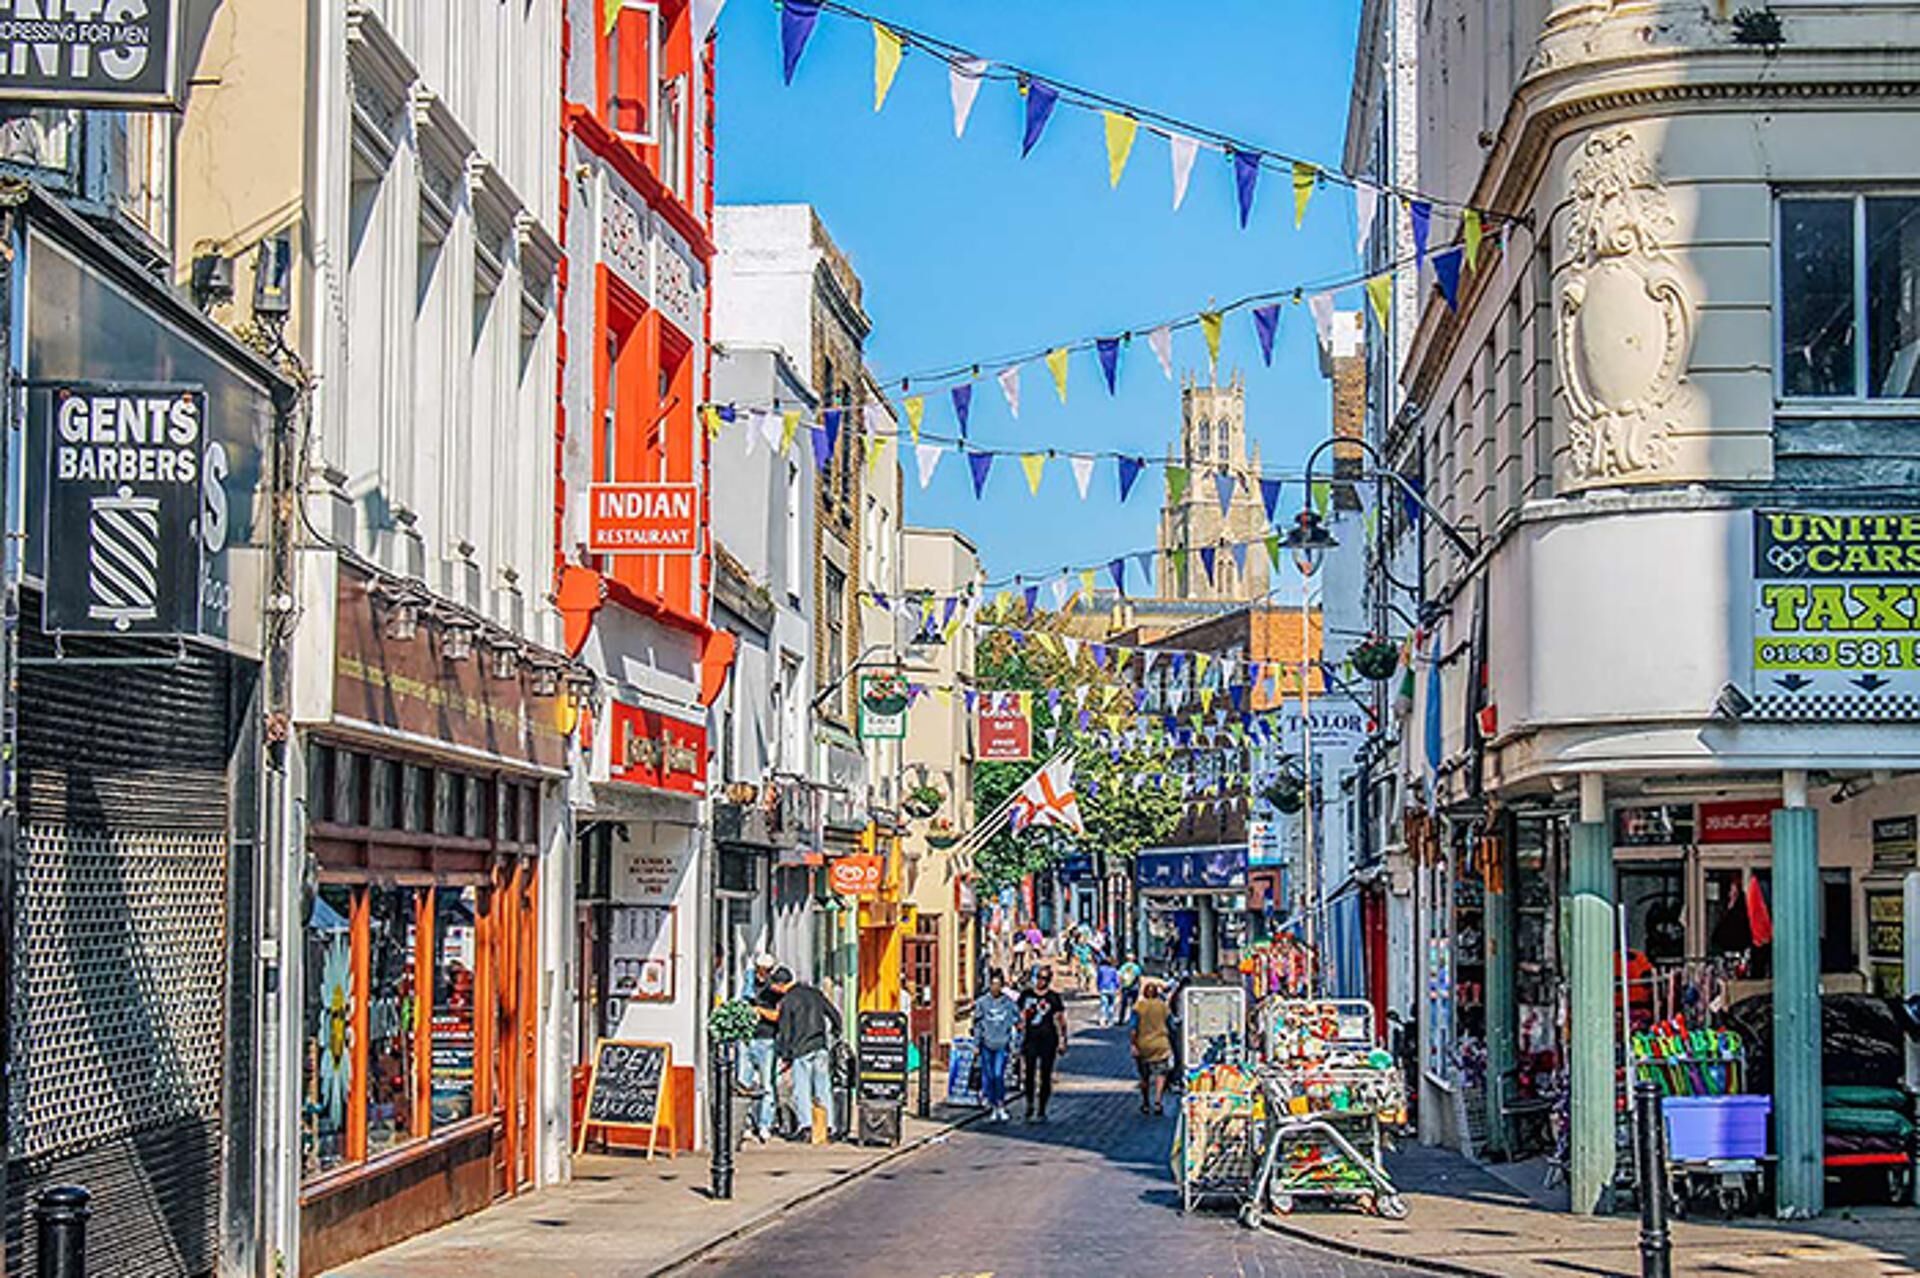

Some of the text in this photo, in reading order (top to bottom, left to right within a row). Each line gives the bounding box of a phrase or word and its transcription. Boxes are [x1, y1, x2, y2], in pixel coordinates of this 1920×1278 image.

[0, 0, 148, 81] NTS
[79, 24, 110, 42] FOR
[114, 26, 149, 43] MEN
[59, 396, 198, 445] GENTS
[58, 447, 196, 482] BARBERS
[600, 492, 690, 518] INDIAN
[597, 528, 690, 543] RESTAURANT
[1762, 584, 1920, 631] TAX
[1761, 645, 1829, 663] 01843
[1285, 715, 1362, 733] TYLOR
